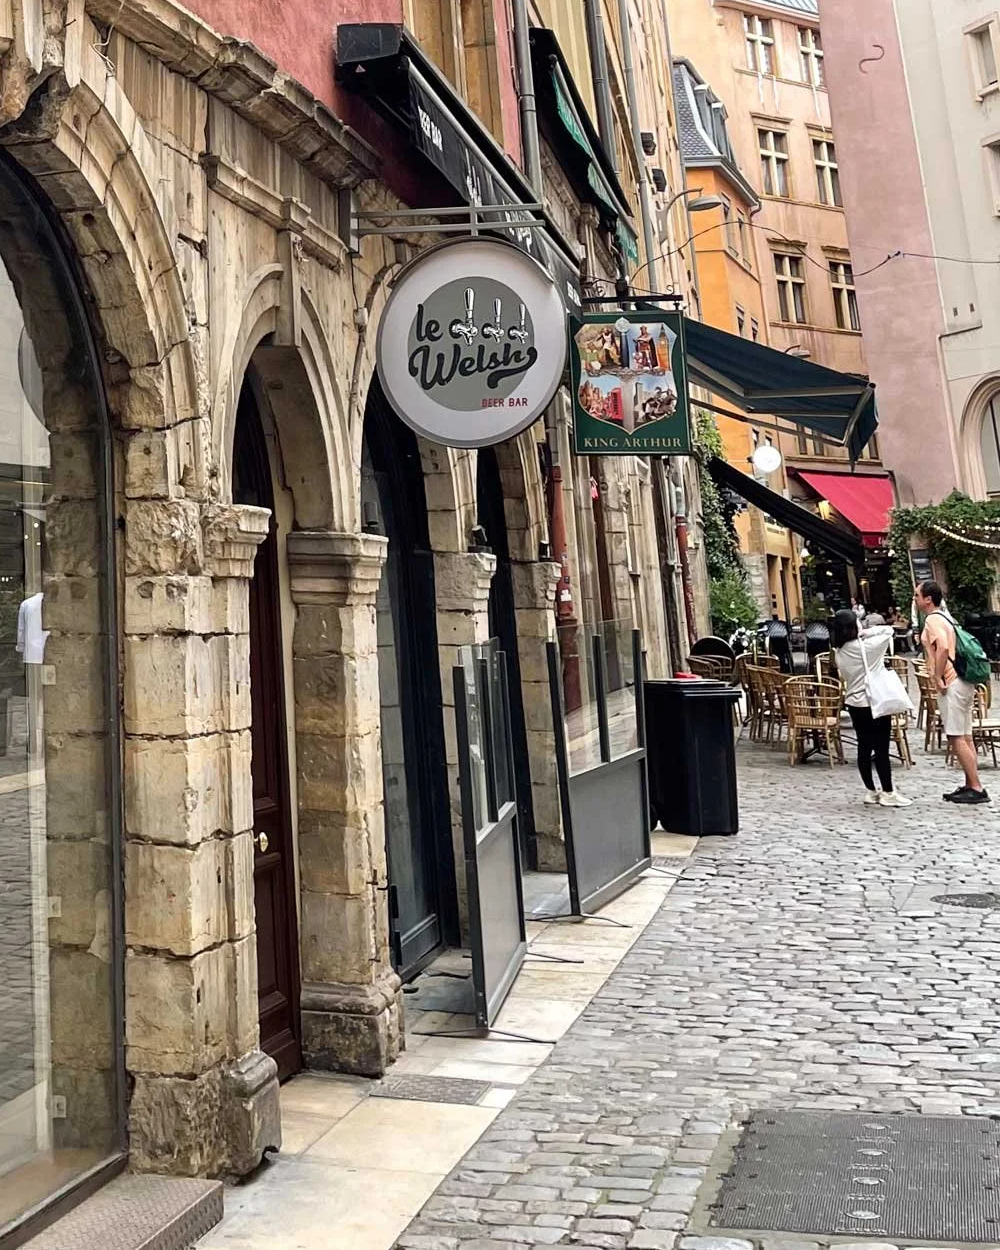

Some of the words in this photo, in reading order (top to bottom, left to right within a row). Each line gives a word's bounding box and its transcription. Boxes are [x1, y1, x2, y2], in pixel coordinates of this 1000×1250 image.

[416, 303, 444, 342] le
[408, 342, 538, 391] Welsh
[481, 398, 505, 408] BEER
[508, 397, 528, 407] BAR
[584, 437, 618, 448] KING
[622, 437, 682, 448] ARTHUR
